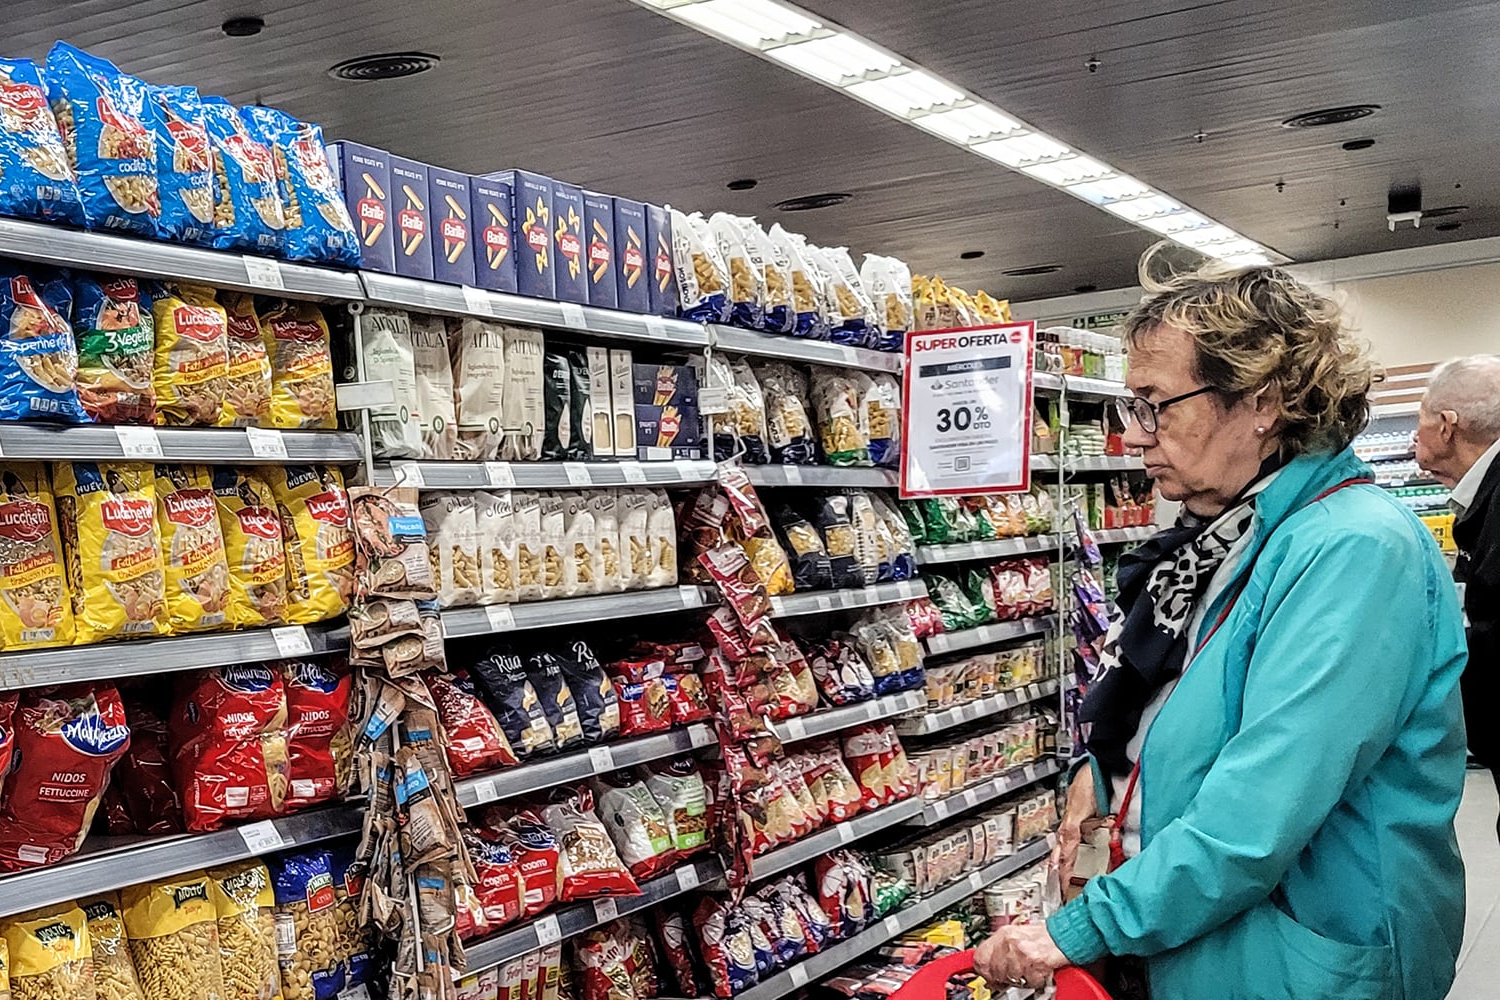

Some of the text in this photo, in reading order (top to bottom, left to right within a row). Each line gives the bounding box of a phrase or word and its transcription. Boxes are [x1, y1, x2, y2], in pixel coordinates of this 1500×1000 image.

[360, 205, 385, 220] Barilla
[400, 213, 426, 231] Barilla
[443, 224, 466, 240] Barilla
[486, 228, 509, 245] Barilla
[528, 230, 549, 247] Barilla
[561, 238, 580, 254] Barilla
[591, 245, 610, 261] Barilla
[915, 333, 1008, 352] SUPER OFERTA
[936, 406, 989, 432] 30 %
[973, 422, 992, 430] DTO
[226, 711, 255, 723] NIDOS
[301, 709, 330, 721] NIDOS
[52, 772, 86, 783] NIDOS
[39, 786, 90, 799] FETTUCCINE
[179, 884, 204, 902] MOLTO
